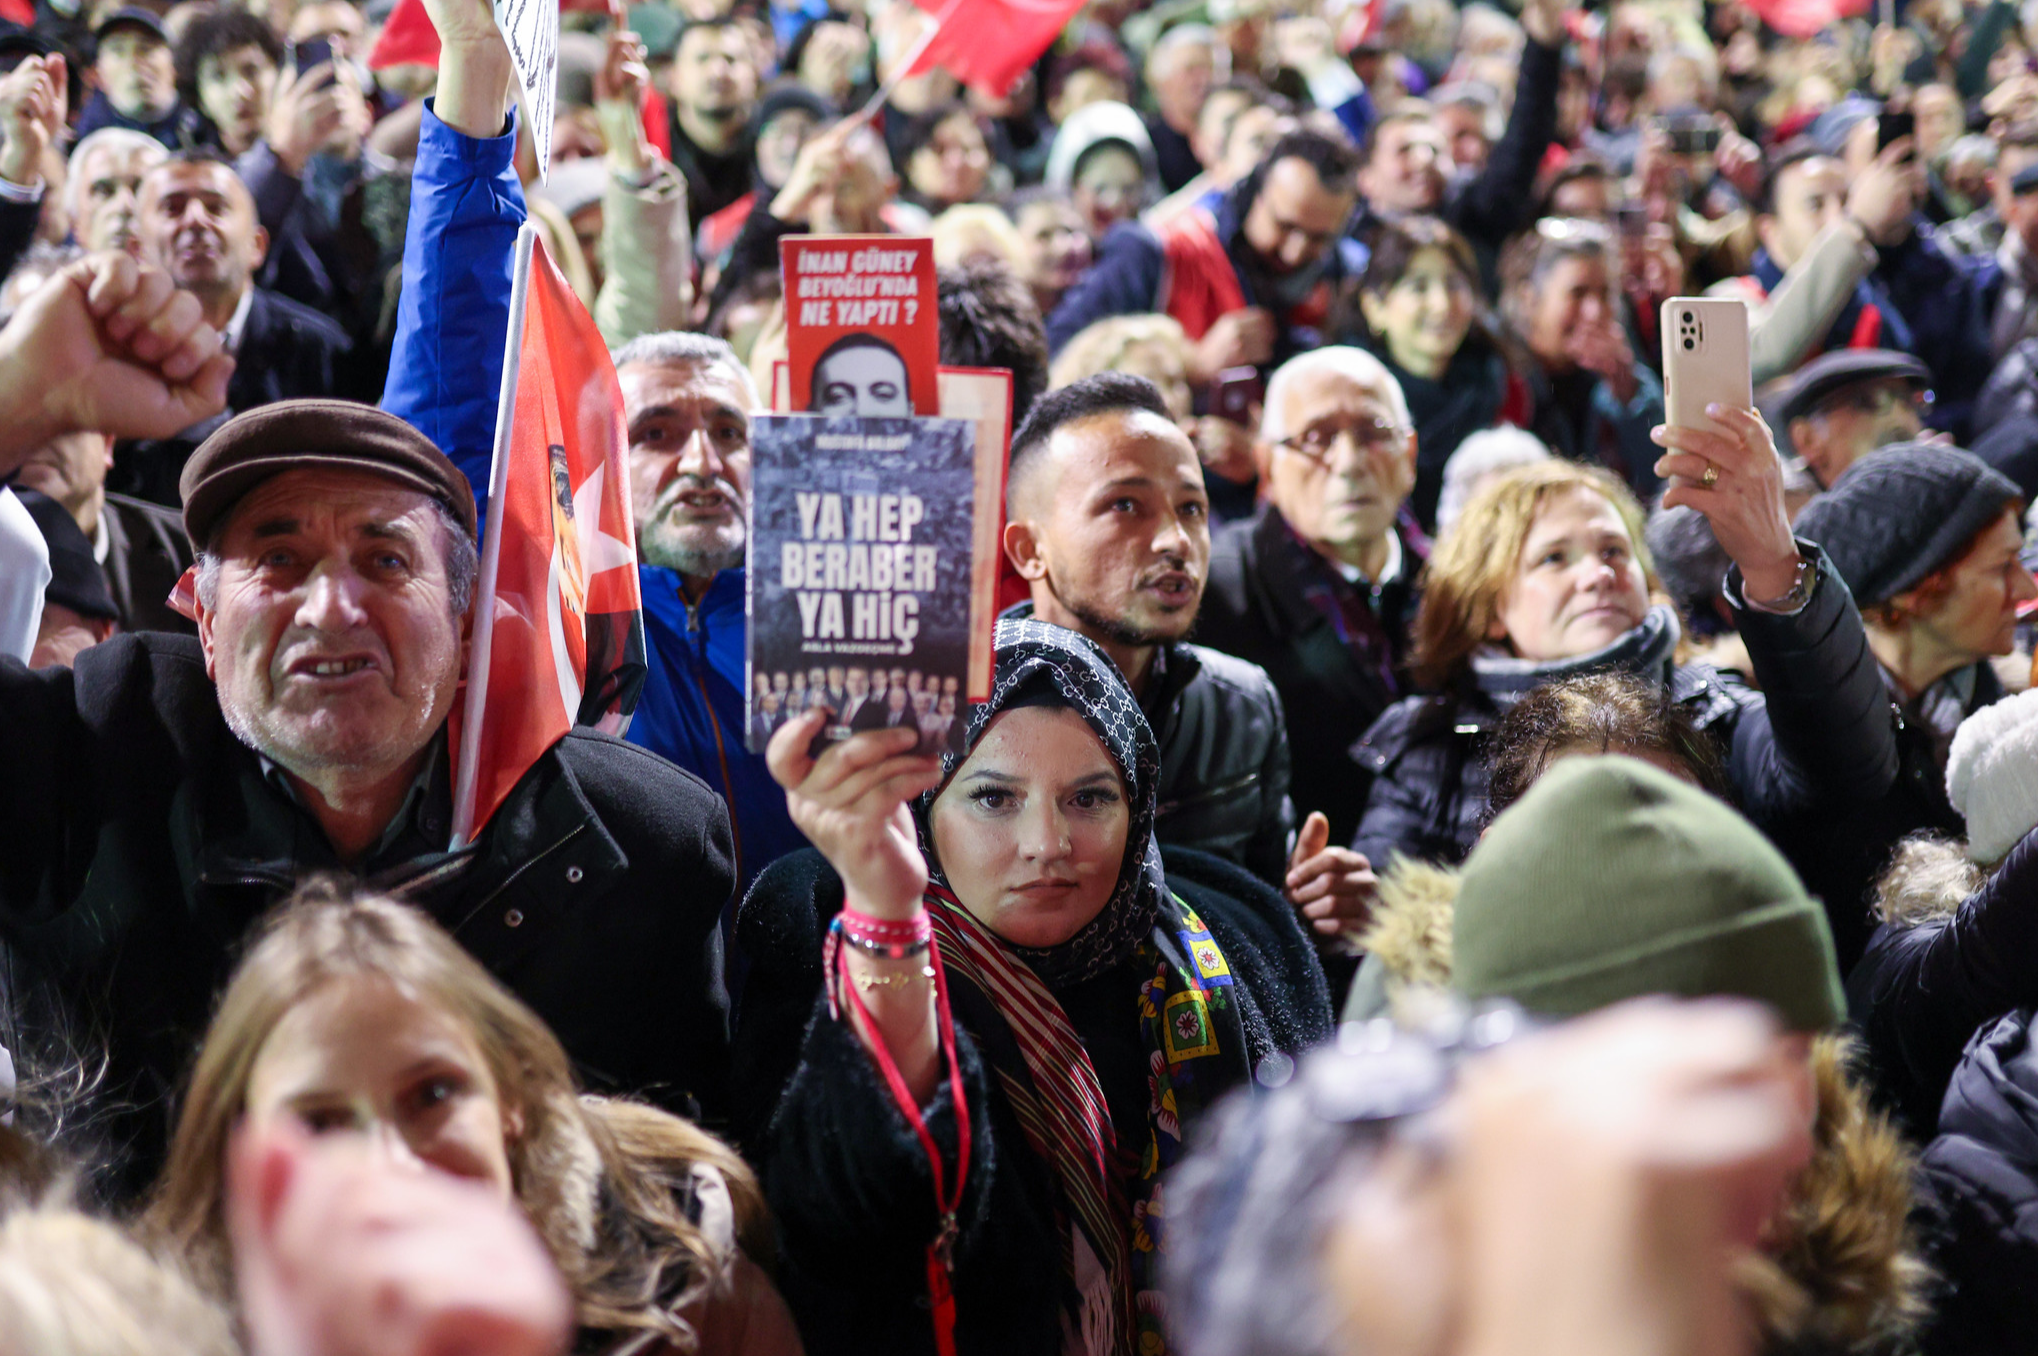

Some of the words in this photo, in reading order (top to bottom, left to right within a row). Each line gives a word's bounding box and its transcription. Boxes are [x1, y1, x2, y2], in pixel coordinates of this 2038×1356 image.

[797, 248, 848, 273] İNAN
[852, 246, 918, 273] GÜNEY
[798, 274, 918, 297] BEYOĞLU'NDA
[800, 301, 832, 326] NE
[837, 300, 899, 325] YAPTI
[904, 300, 918, 325] ?
[797, 492, 845, 540] YA
[853, 493, 924, 541] HEP
[782, 542, 936, 591] BERABER
[797, 592, 845, 638] YA
